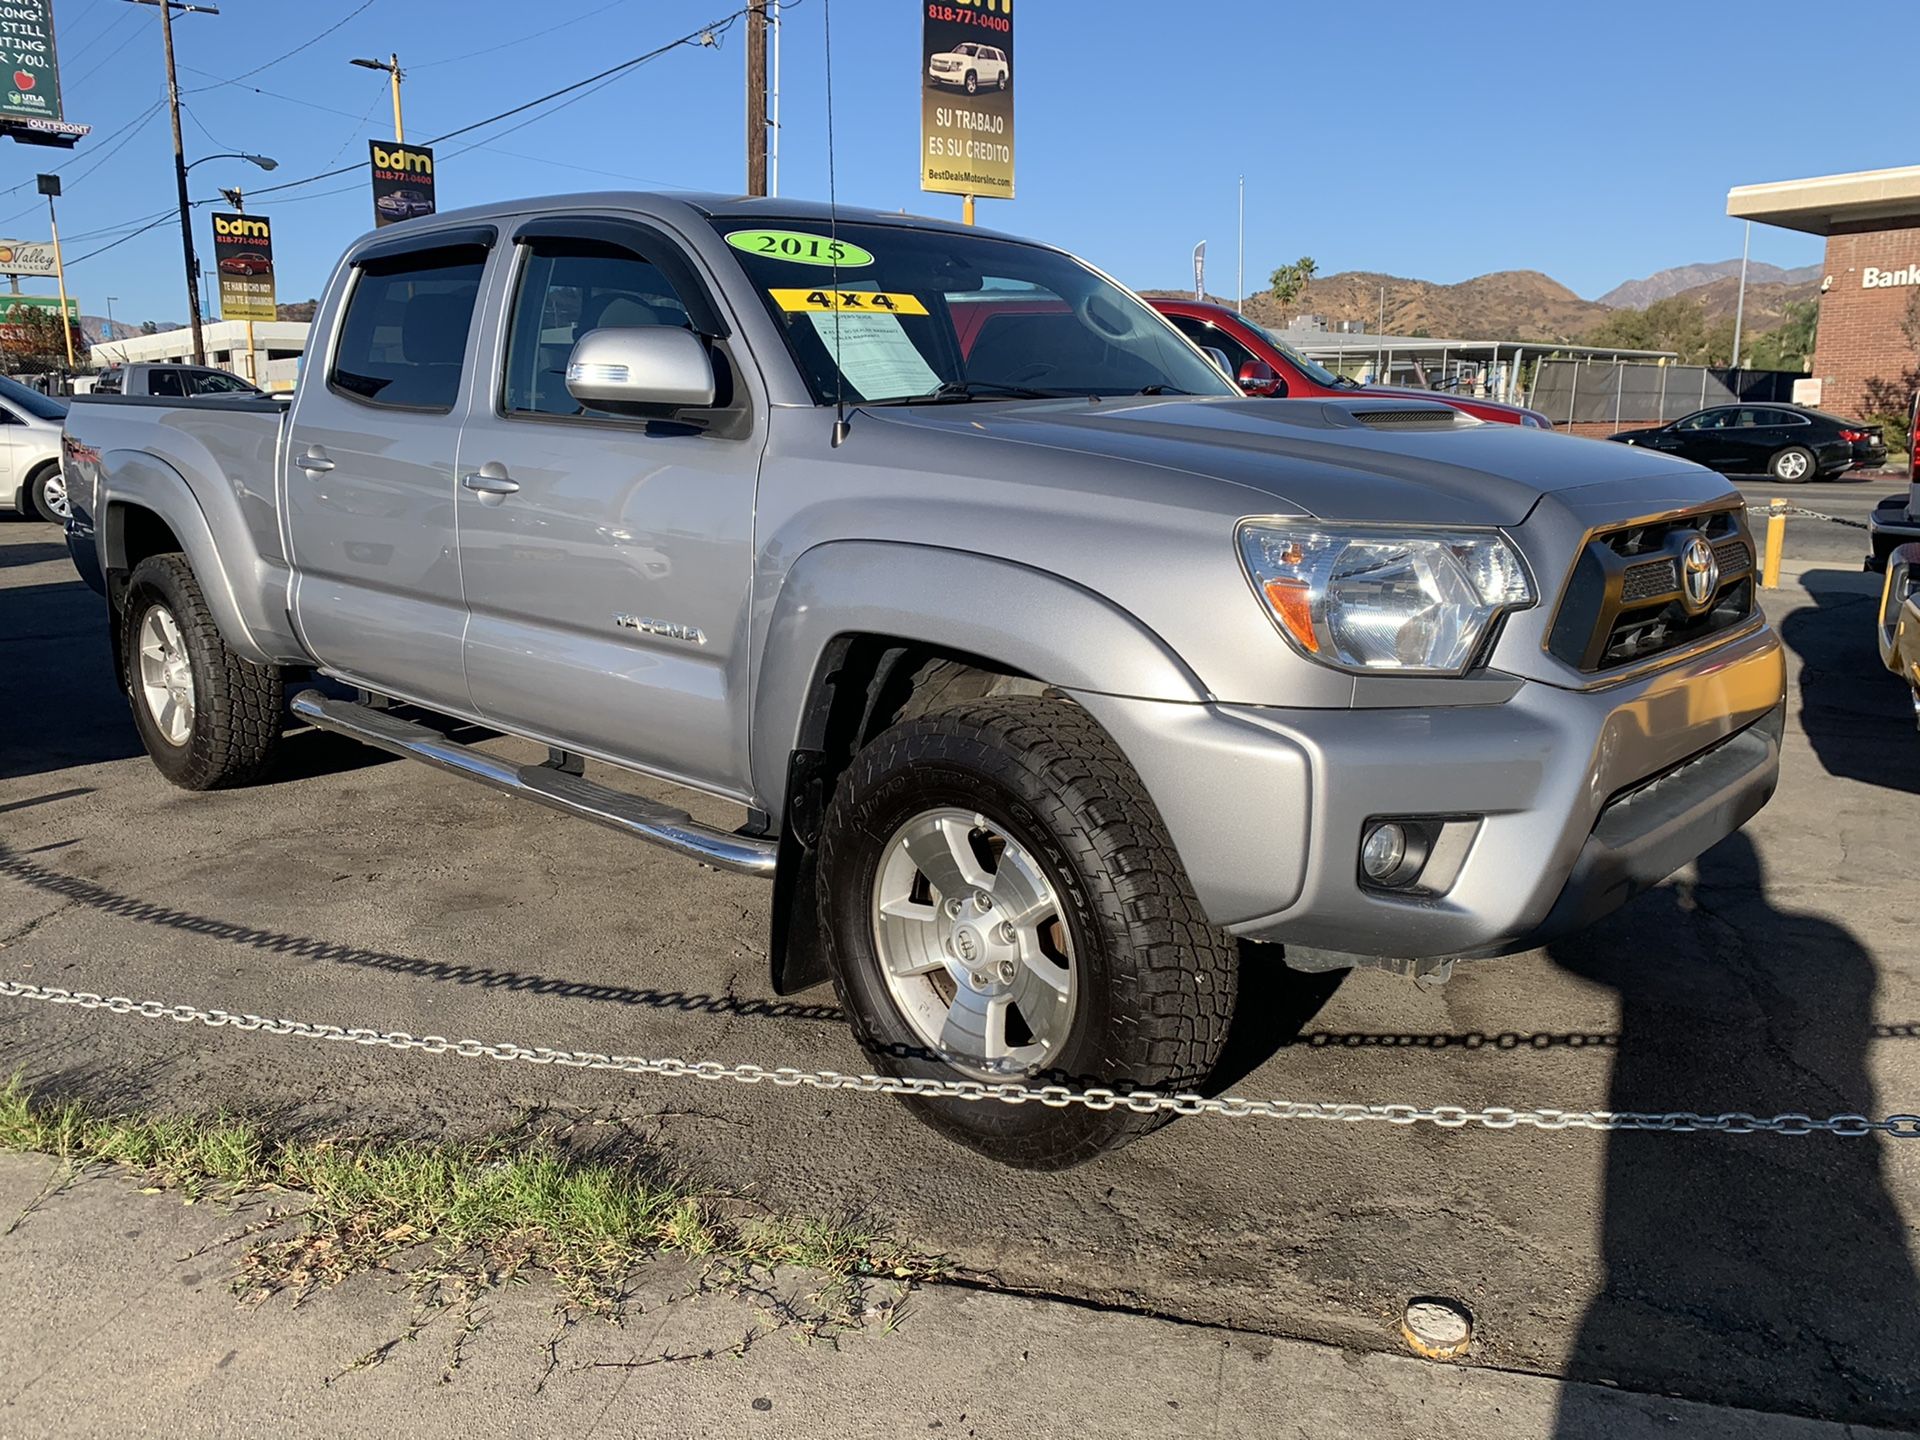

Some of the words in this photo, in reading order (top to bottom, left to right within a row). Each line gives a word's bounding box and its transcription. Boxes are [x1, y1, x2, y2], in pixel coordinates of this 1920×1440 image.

[928, 4, 1010, 32] 818-771-0400
[1, 21, 46, 38] STILL
[12, 52, 49, 68] YOU.
[21, 93, 46, 103] UTLA
[29, 119, 89, 134] OUTFRONT
[936, 107, 952, 127] SU
[955, 109, 1004, 134] TRABAJO
[373, 146, 433, 174] bdm
[928, 136, 944, 155] ES
[947, 138, 963, 157] SU
[966, 140, 1010, 163] CREDITO
[375, 170, 433, 185] 818-771-0400
[928, 169, 1011, 187] BestDealsMotorsInc.com
[214, 216, 270, 238] bdm
[216, 235, 270, 246] 818-771-0400
[757, 235, 846, 261] 2015
[14, 247, 55, 271] Valley
[1862, 264, 1920, 289] Bank
